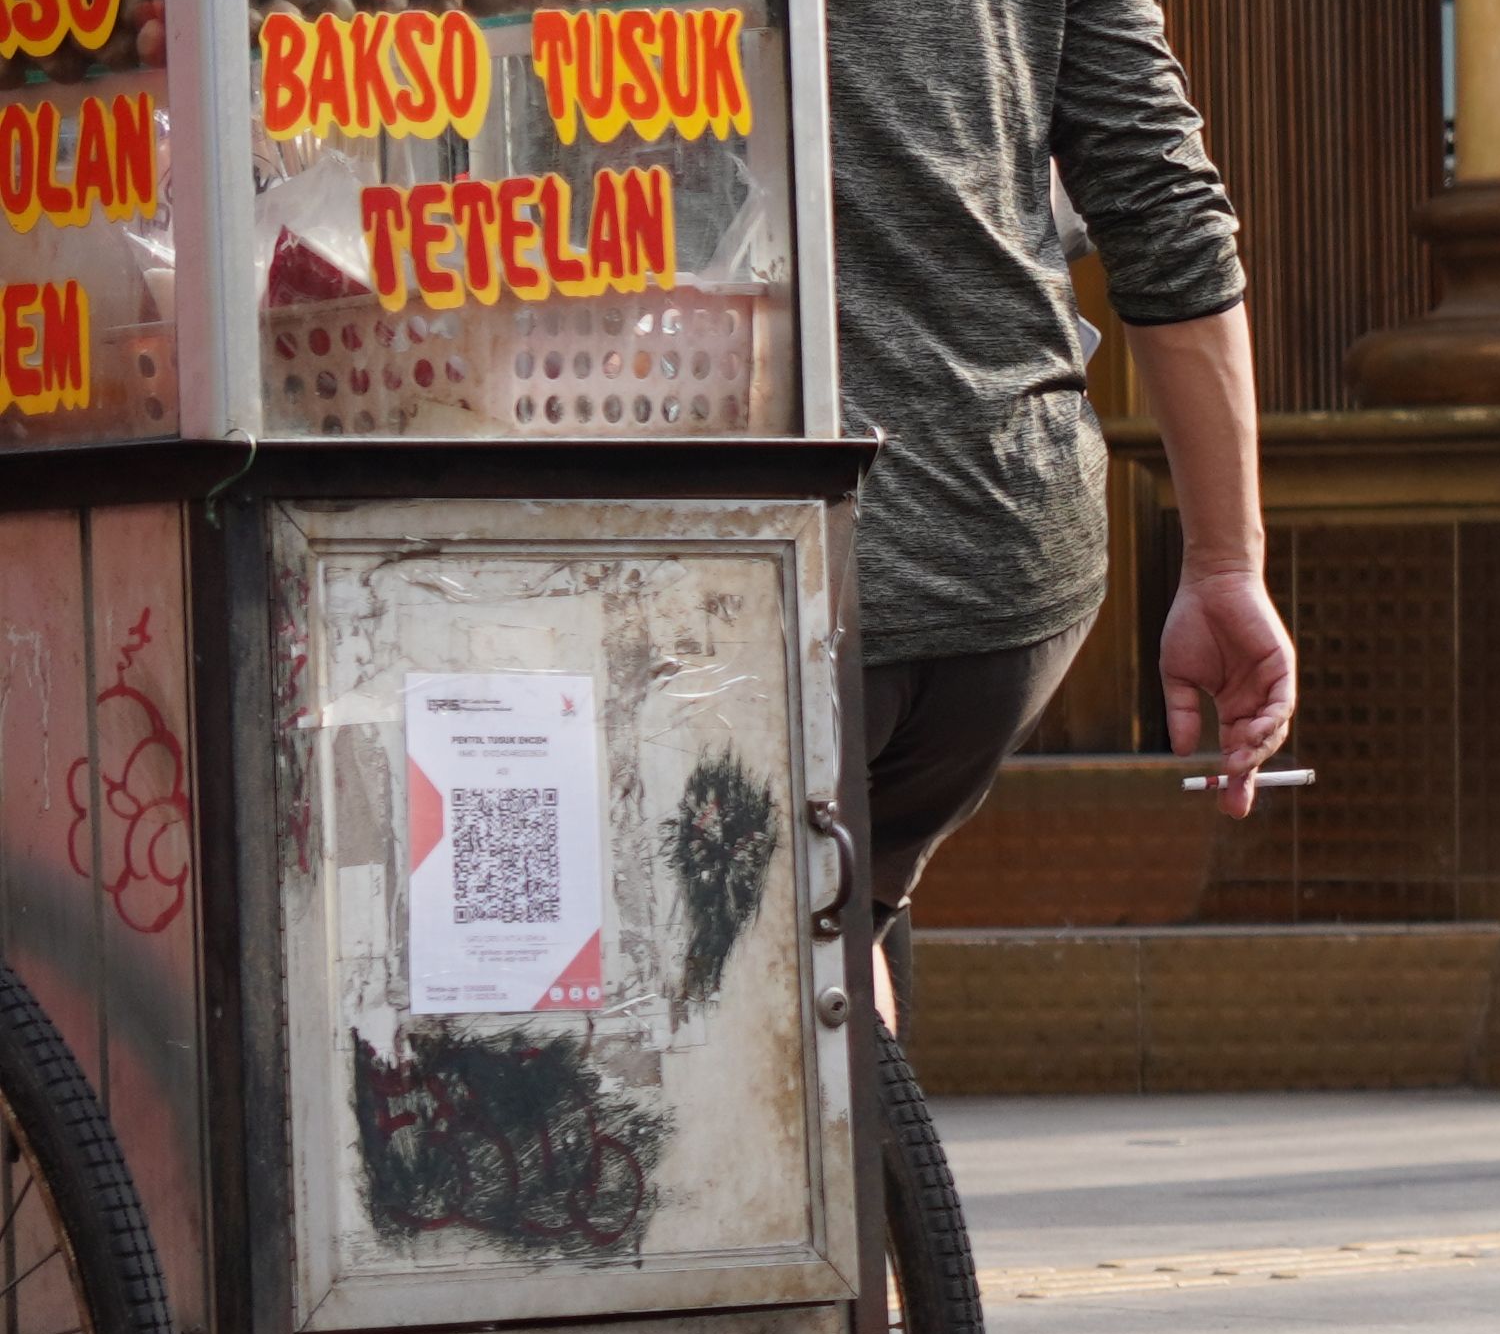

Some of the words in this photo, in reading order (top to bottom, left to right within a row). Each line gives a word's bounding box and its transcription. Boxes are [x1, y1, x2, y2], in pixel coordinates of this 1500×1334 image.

[259, 10, 491, 141] BAKSO
[532, 9, 753, 146] TUSUK
[360, 166, 674, 310] TETELAN
